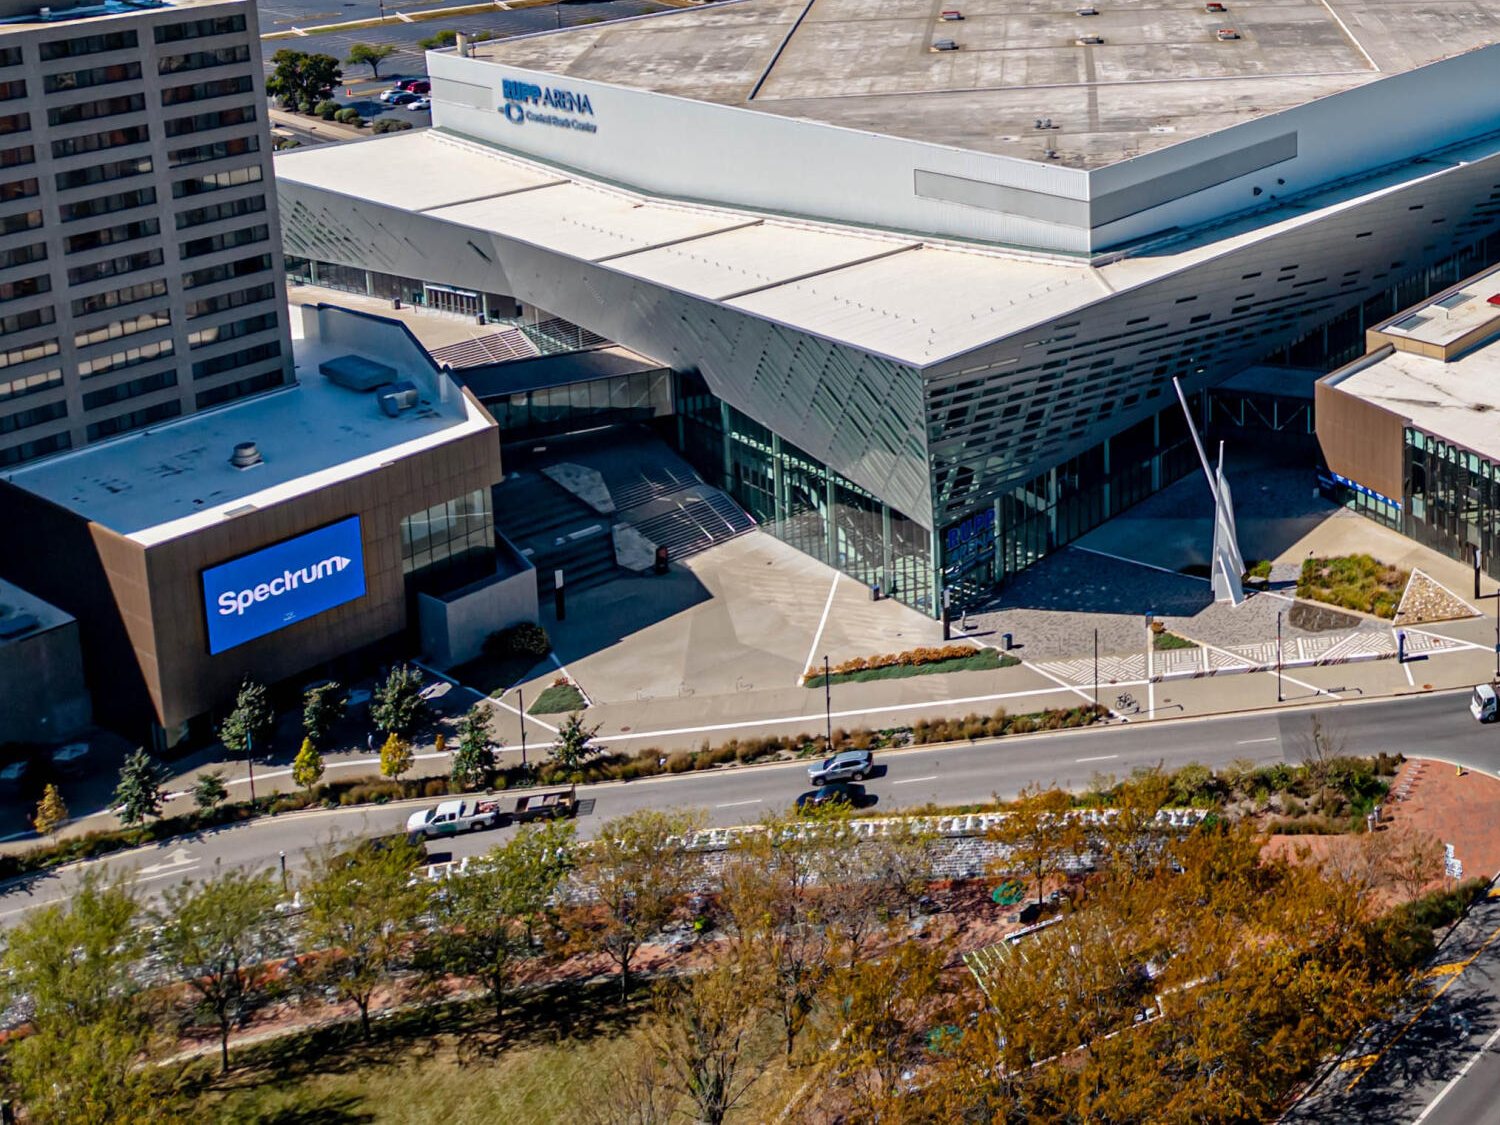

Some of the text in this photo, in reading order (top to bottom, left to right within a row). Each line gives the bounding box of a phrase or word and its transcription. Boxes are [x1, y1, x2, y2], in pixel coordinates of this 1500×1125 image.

[502, 78, 593, 115] RUPP ARENA
[948, 508, 995, 550] RUPP
[218, 555, 343, 615] Spectrum
